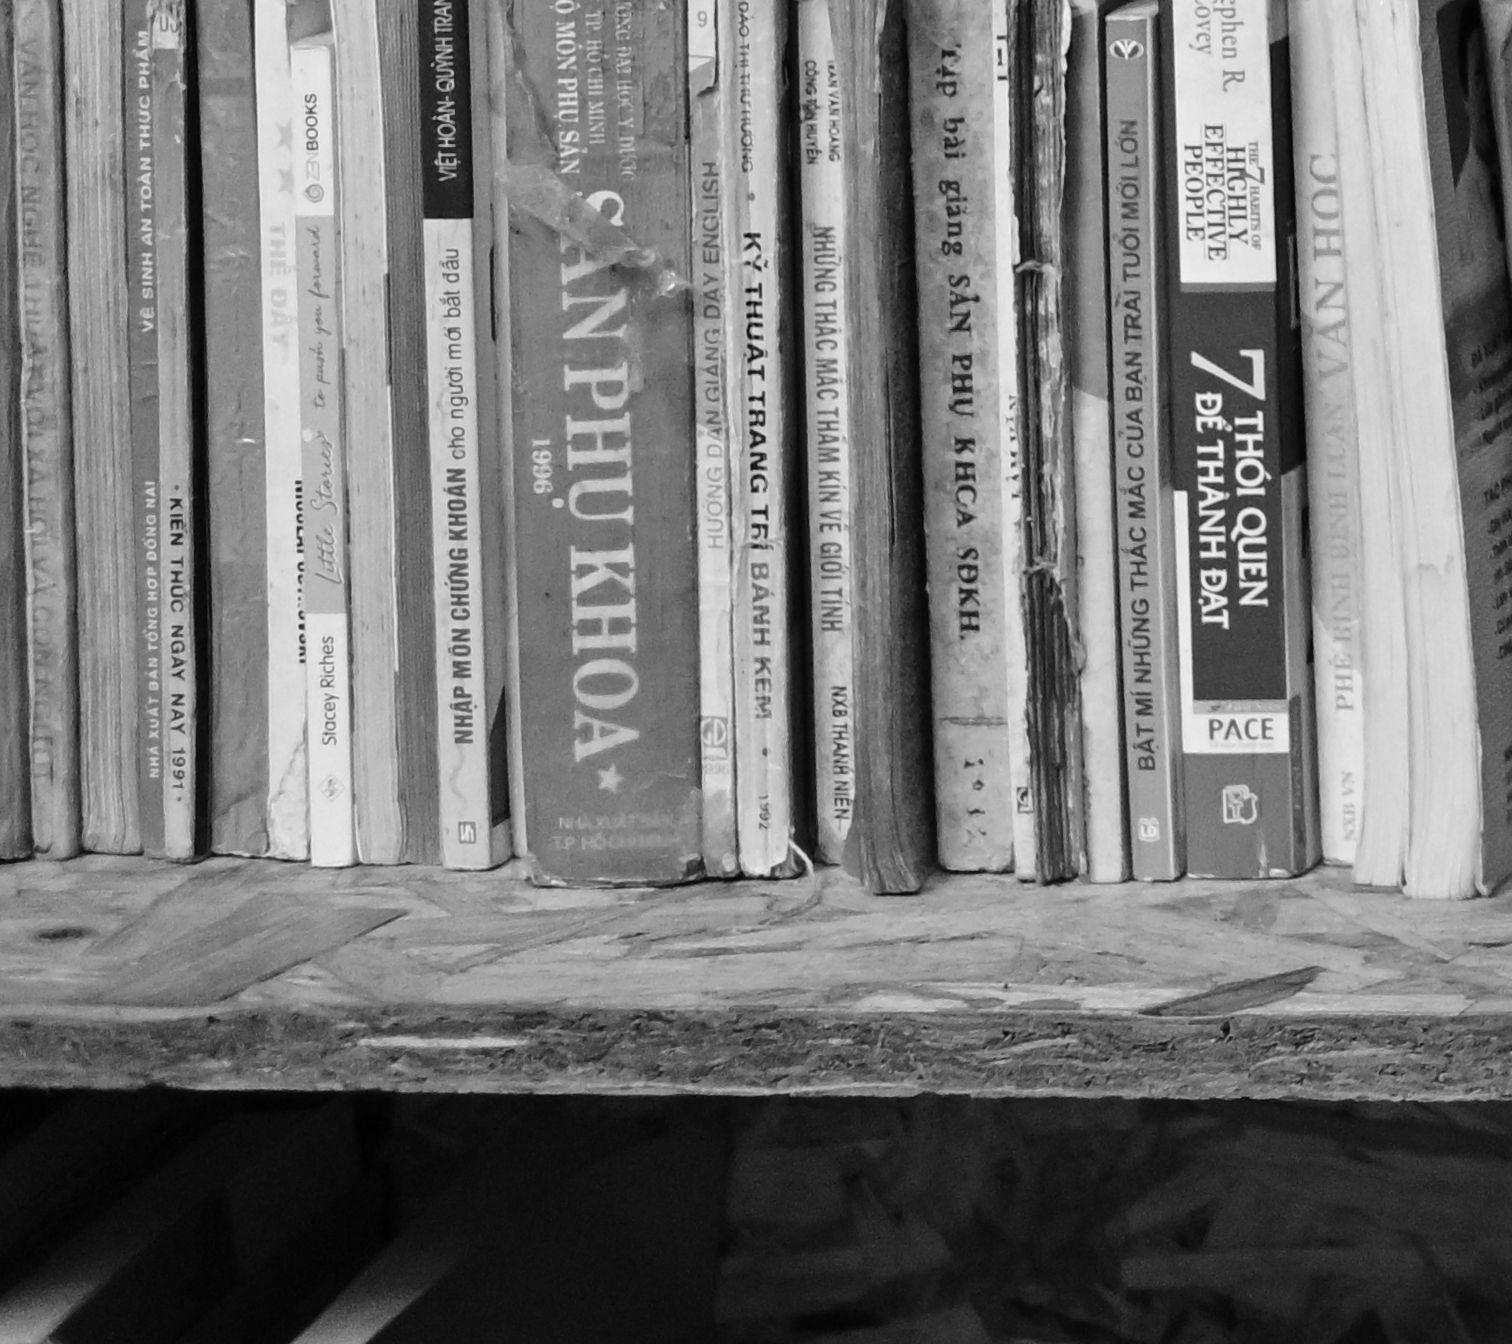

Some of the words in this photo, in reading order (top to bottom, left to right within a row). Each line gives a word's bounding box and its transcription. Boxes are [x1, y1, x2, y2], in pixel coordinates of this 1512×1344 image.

[1222, 70, 1246, 93] R.
[1248, 141, 1259, 165] THE
[1184, 145, 1206, 241] PEOPLE
[1204, 125, 1227, 260] EFFECTIVE
[1226, 147, 1249, 244] HIGHLY
[1249, 186, 1263, 232] HABITS
[439, 248, 460, 284] đầu
[1251, 234, 1261, 250] OF
[439, 290, 461, 318] bắt
[444, 327, 462, 360] mới
[437, 367, 469, 419] người
[1191, 348, 1267, 402] 7
[1195, 392, 1233, 433] ĐỂ
[448, 426, 466, 460] cho
[532, 439, 553, 494] 1996
[552, 361, 640, 525] PHỤ
[1234, 410, 1272, 496] THÓI
[443, 468, 468, 541] KHOÁN
[1197, 439, 1232, 558] THÀNH
[1233, 507, 1268, 606] QUEN
[444, 548, 470, 621] CHỨNG
[1198, 568, 1229, 629] ĐẠT
[448, 628, 472, 679] MÔN
[570, 542, 640, 763] KHOA
[449, 686, 477, 744] NHẬP
[1209, 718, 1273, 740] PACE
